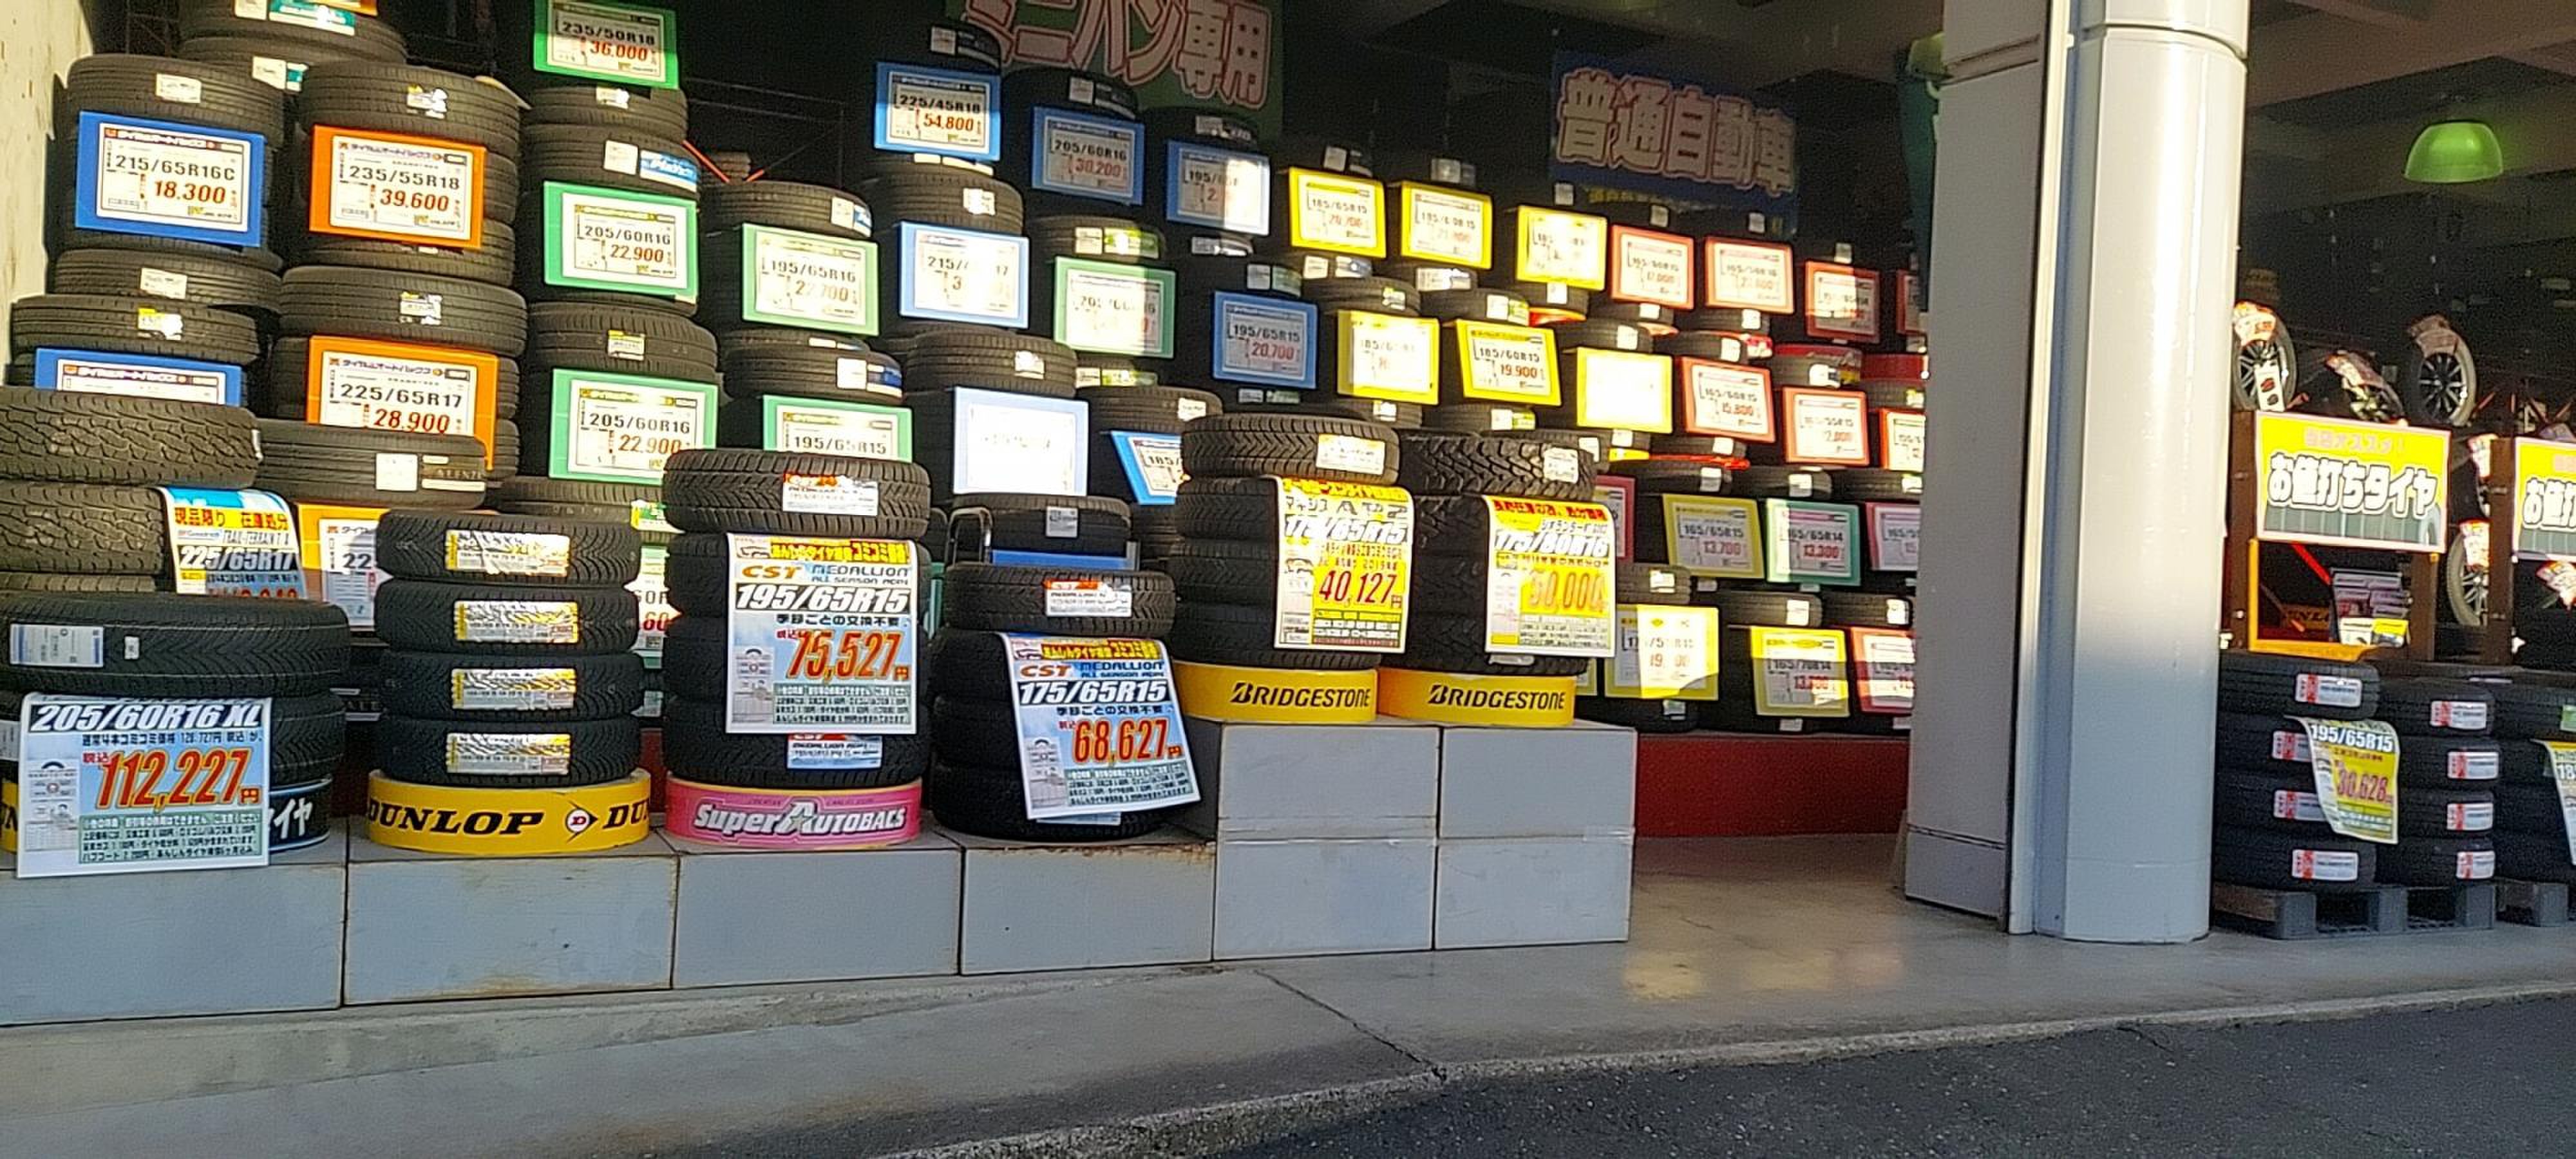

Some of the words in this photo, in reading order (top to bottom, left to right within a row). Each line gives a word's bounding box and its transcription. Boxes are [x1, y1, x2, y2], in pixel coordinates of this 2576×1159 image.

[899, 95, 981, 113] 225/45R18
[1557, 66, 1795, 197] 普通自動車
[115, 155, 236, 181] 215/65R16C
[349, 165, 460, 191] 235/55R18
[340, 383, 462, 408] 225/65R17
[590, 413, 691, 434] 205/60R16
[2268, 452, 2438, 516] お値打ちタイヤ
[180, 545, 296, 570] 225/65R17
[741, 565, 802, 579] CST
[812, 564, 909, 578] MEDALLION
[737, 584, 911, 613] 195/65R15
[1021, 664, 1072, 677] CST
[1081, 661, 1164, 671] MEDALLION
[1020, 681, 1167, 704] 175/65R15
[1230, 681, 1370, 708] BRIDGESTONE
[1428, 683, 1566, 711] BRIDGESTONE
[30, 704, 220, 732] 205/60R16
[222, 704, 261, 729] XL
[2311, 724, 2393, 752] 195/65R15
[269, 796, 314, 839] イヤ
[368, 796, 544, 836] DUNLOP
